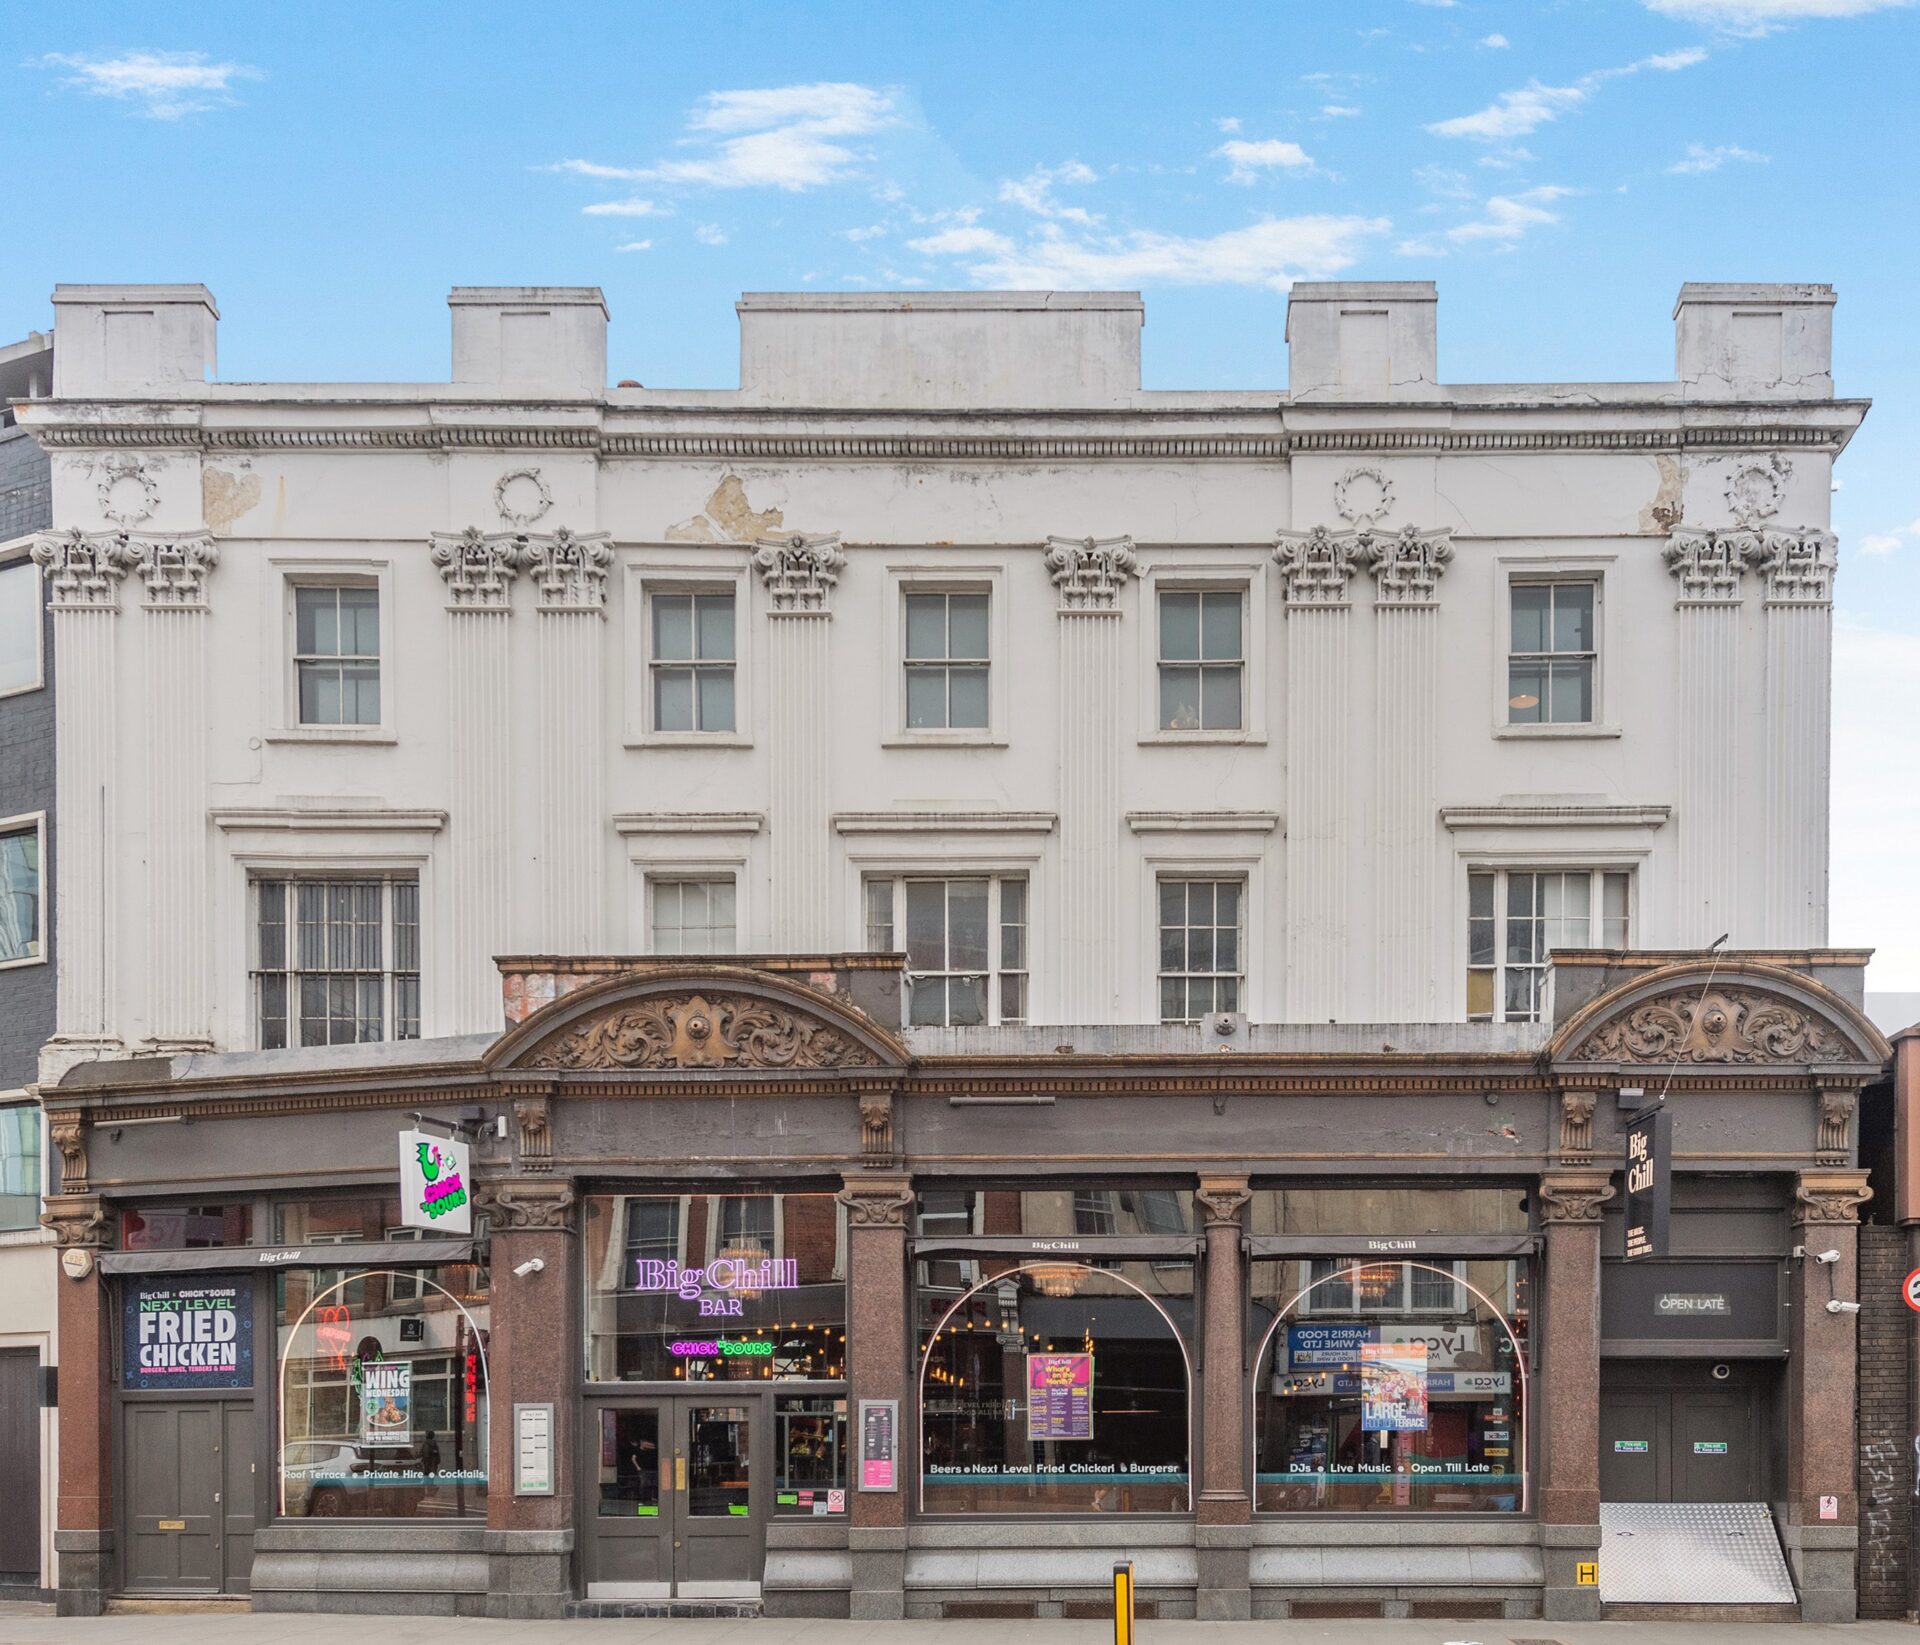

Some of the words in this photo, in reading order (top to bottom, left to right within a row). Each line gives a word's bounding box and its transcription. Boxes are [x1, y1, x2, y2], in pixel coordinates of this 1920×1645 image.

[1629, 1131, 1648, 1161] Big
[1628, 1158, 1654, 1194] Chill
[429, 1187, 467, 1219] SOURS
[140, 1300, 182, 1311] NEXT
[185, 1299, 236, 1310] LEVEL
[699, 1299, 742, 1316] BAR
[1660, 1298, 1693, 1309] OPEN
[1698, 1299, 1725, 1309] LATE
[140, 1310, 236, 1344] FRIED
[140, 1342, 236, 1367] CHICKEN
[671, 1342, 719, 1355] CHICK
[723, 1342, 772, 1355] SOURS
[365, 1369, 410, 1388] WING
[366, 1388, 410, 1398] WEDNESDAY
[1366, 1402, 1406, 1419] LARGE
[1395, 1418, 1425, 1428] TERRACE
[284, 1470, 306, 1479] Roof
[309, 1470, 346, 1479] Terrace
[363, 1470, 399, 1479] Private
[403, 1470, 424, 1479] Hire
[438, 1469, 485, 1479] Cocktails
[930, 1464, 961, 1473] Beers
[972, 1464, 998, 1473] Next
[1003, 1464, 1032, 1473] Level
[1036, 1464, 1065, 1473] Fried
[1290, 1463, 1311, 1473] DJs
[1330, 1463, 1354, 1473] Live
[1358, 1463, 1391, 1473] Music
[1411, 1463, 1442, 1474] Open
[1445, 1463, 1461, 1472] Till
[1465, 1463, 1490, 1472] Late
[1580, 1565, 1595, 1582] H
